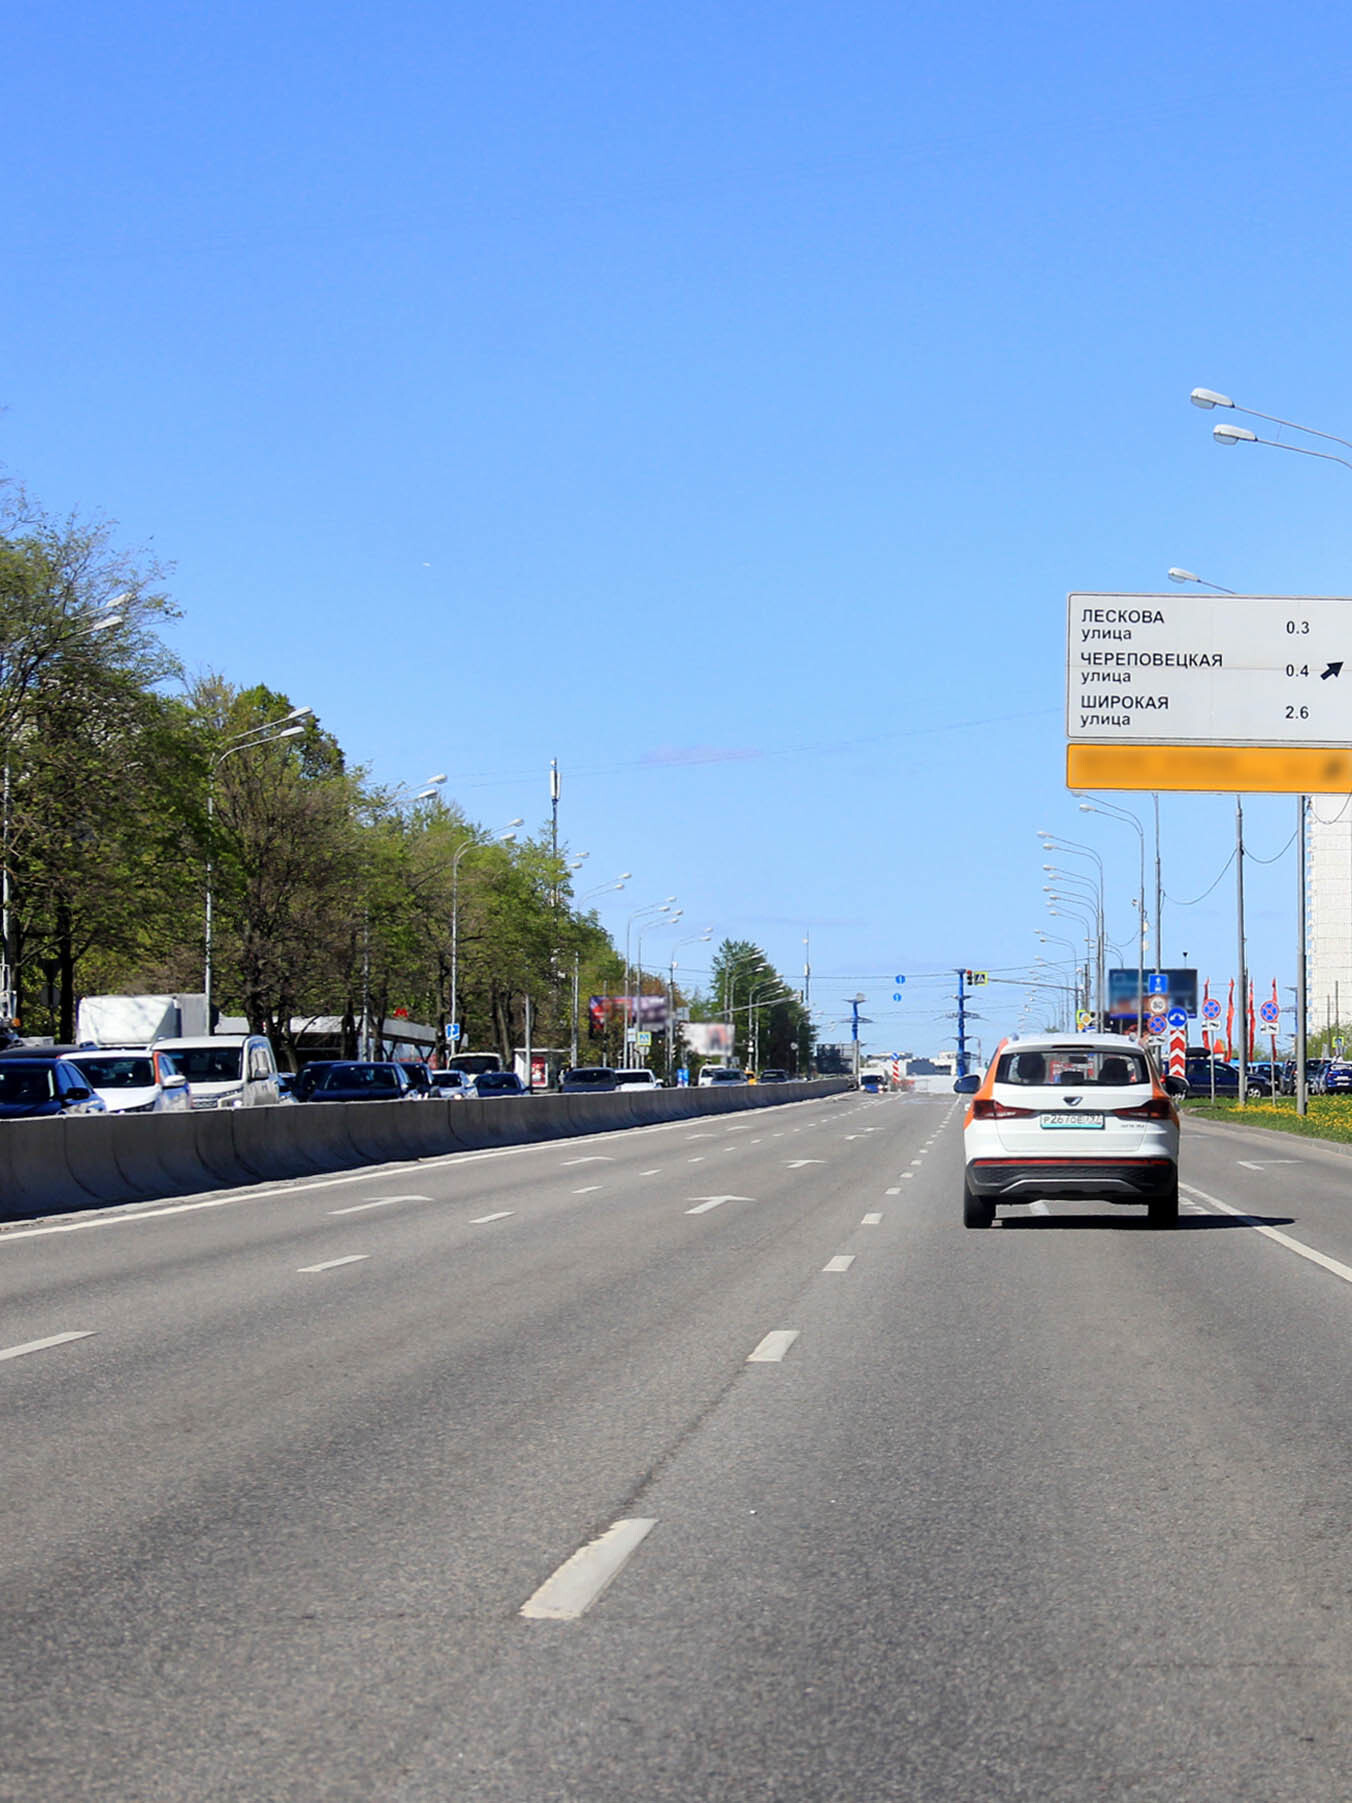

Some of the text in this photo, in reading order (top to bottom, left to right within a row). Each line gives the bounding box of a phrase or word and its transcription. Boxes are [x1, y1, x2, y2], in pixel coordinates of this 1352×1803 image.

[1081, 609, 1165, 623] ЛЕСКОВА
[1081, 627, 1132, 641] улица
[1285, 620, 1311, 635] 0.3
[1081, 652, 1223, 668] ЧЕРЕПОВЕЦКАЯ
[1080, 670, 1132, 685] улица
[1285, 663, 1310, 678] 0.4
[1081, 695, 1169, 710] ШИРОКАЯ
[1284, 705, 1310, 720] 2.6
[1080, 713, 1131, 728] улица
